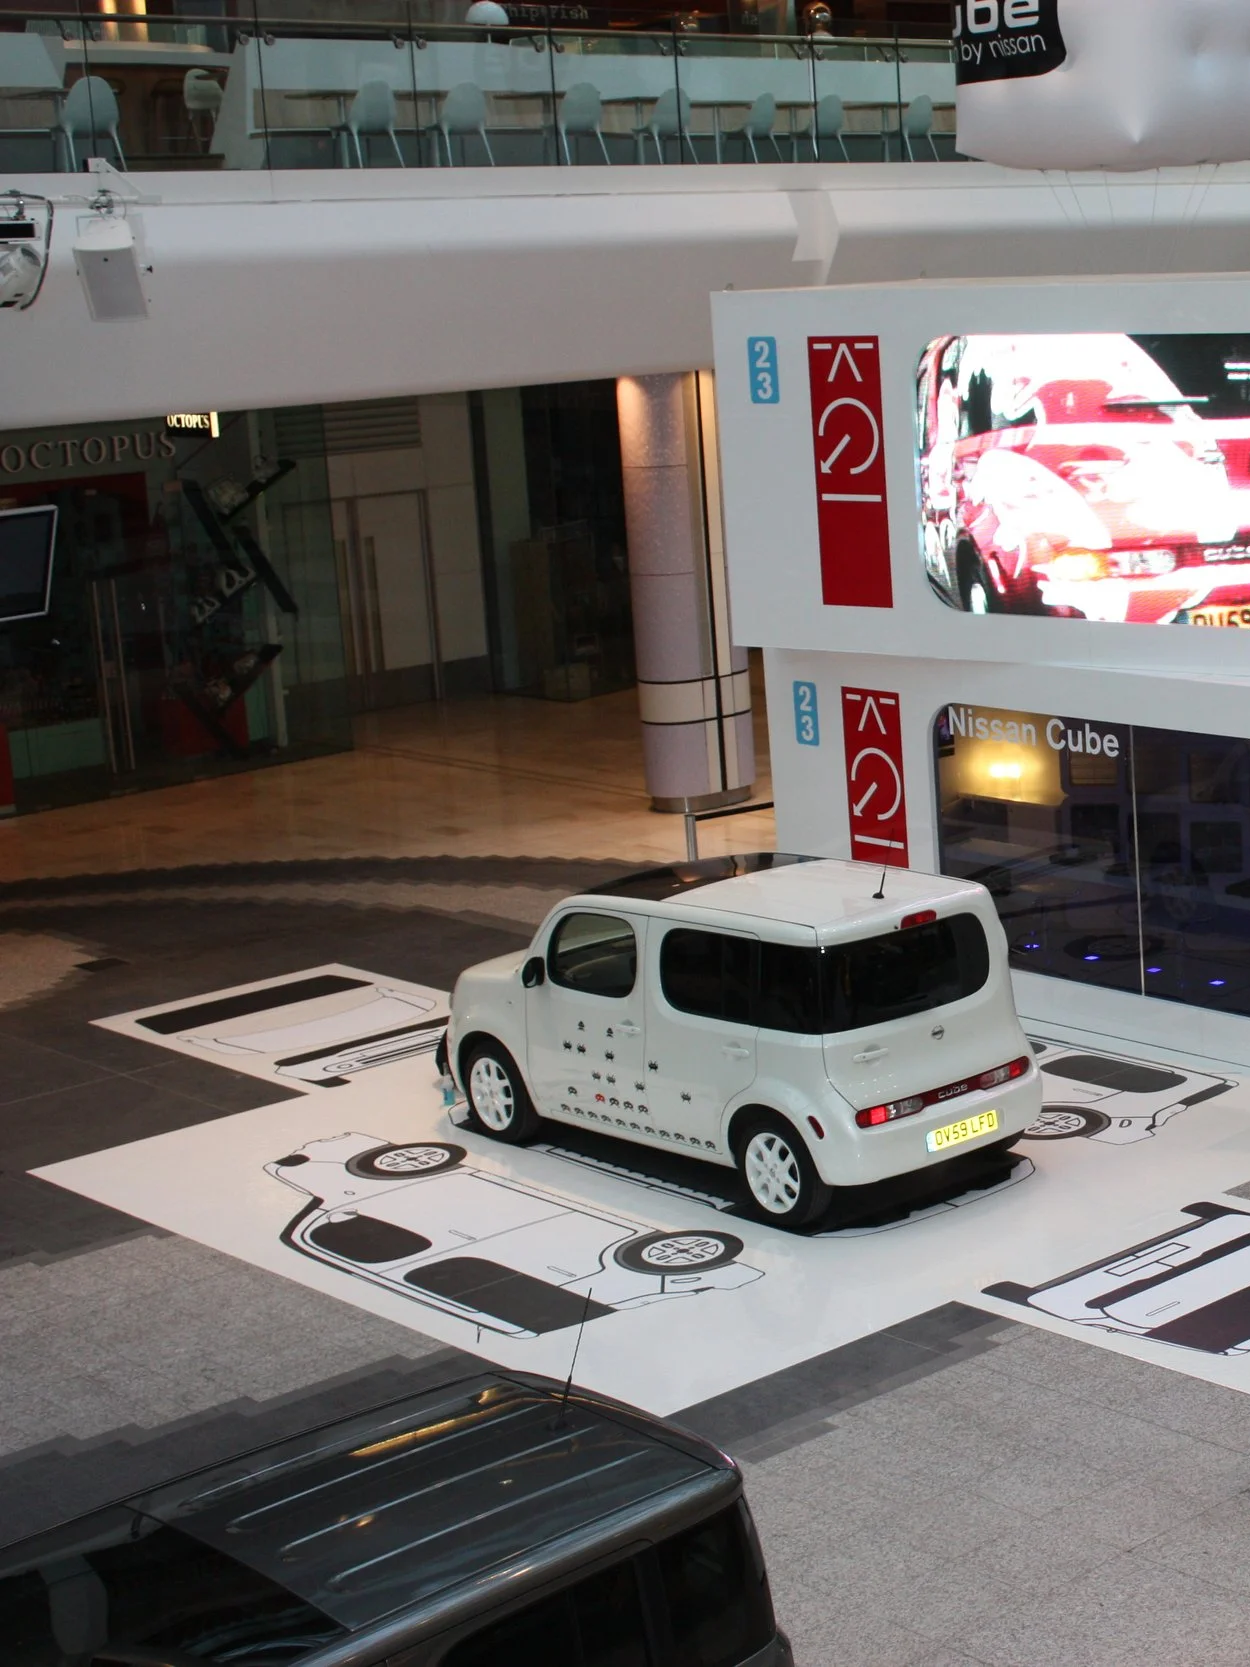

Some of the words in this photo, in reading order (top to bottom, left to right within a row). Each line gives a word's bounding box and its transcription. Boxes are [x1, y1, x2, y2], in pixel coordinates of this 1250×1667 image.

[960, 40, 982, 65] by
[989, 33, 1047, 58] nissan
[167, 414, 210, 429] OCTOPUS
[0, 431, 176, 473] OCTOPUS
[948, 706, 1036, 747] Nissan
[1046, 718, 1120, 758] Cube
[935, 1122, 968, 1146] OV59
[970, 1112, 995, 1133] LFD
